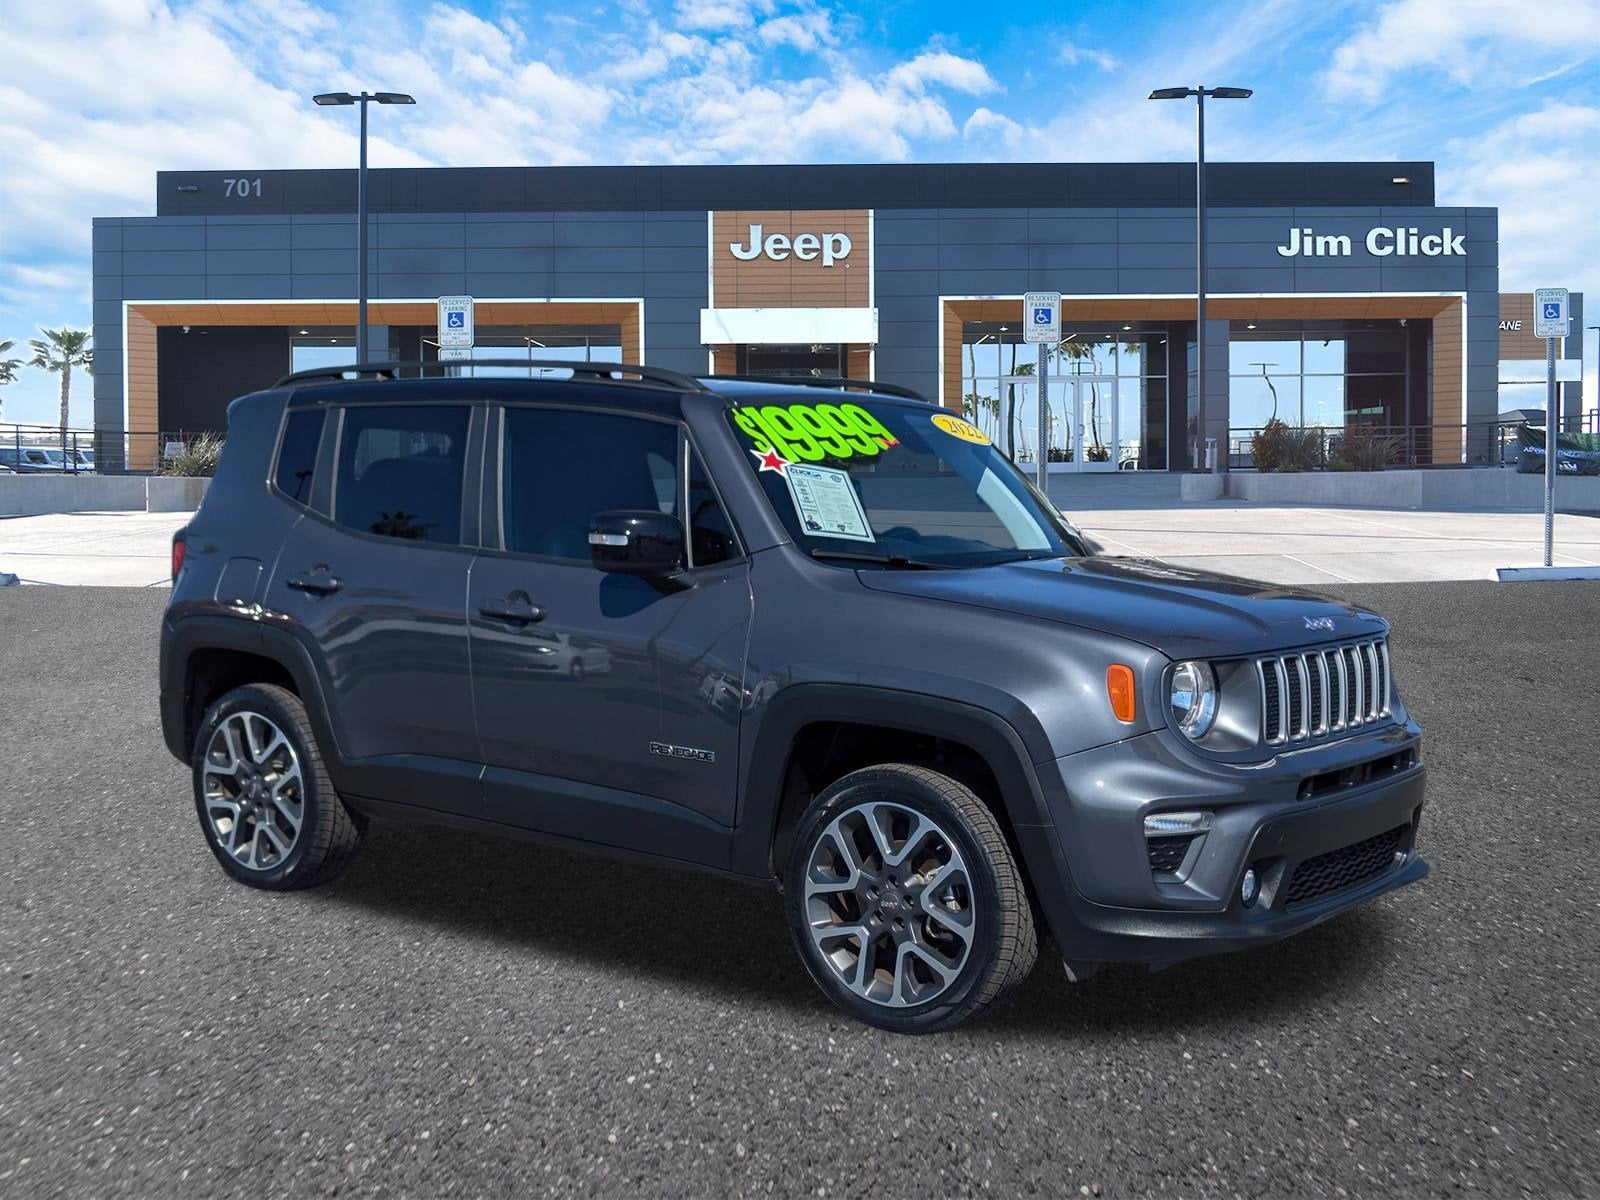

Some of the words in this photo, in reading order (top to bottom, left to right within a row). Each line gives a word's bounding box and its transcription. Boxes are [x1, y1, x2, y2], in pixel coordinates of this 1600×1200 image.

[223, 178, 262, 198] 701
[730, 224, 852, 267] Jeep
[1277, 228, 1352, 257] Jim
[1365, 227, 1467, 256] Click
[1498, 320, 1522, 331] ANE
[942, 418, 983, 440] 2022
[1302, 616, 1336, 631] Jeep
[649, 741, 715, 763] RENEGADE
